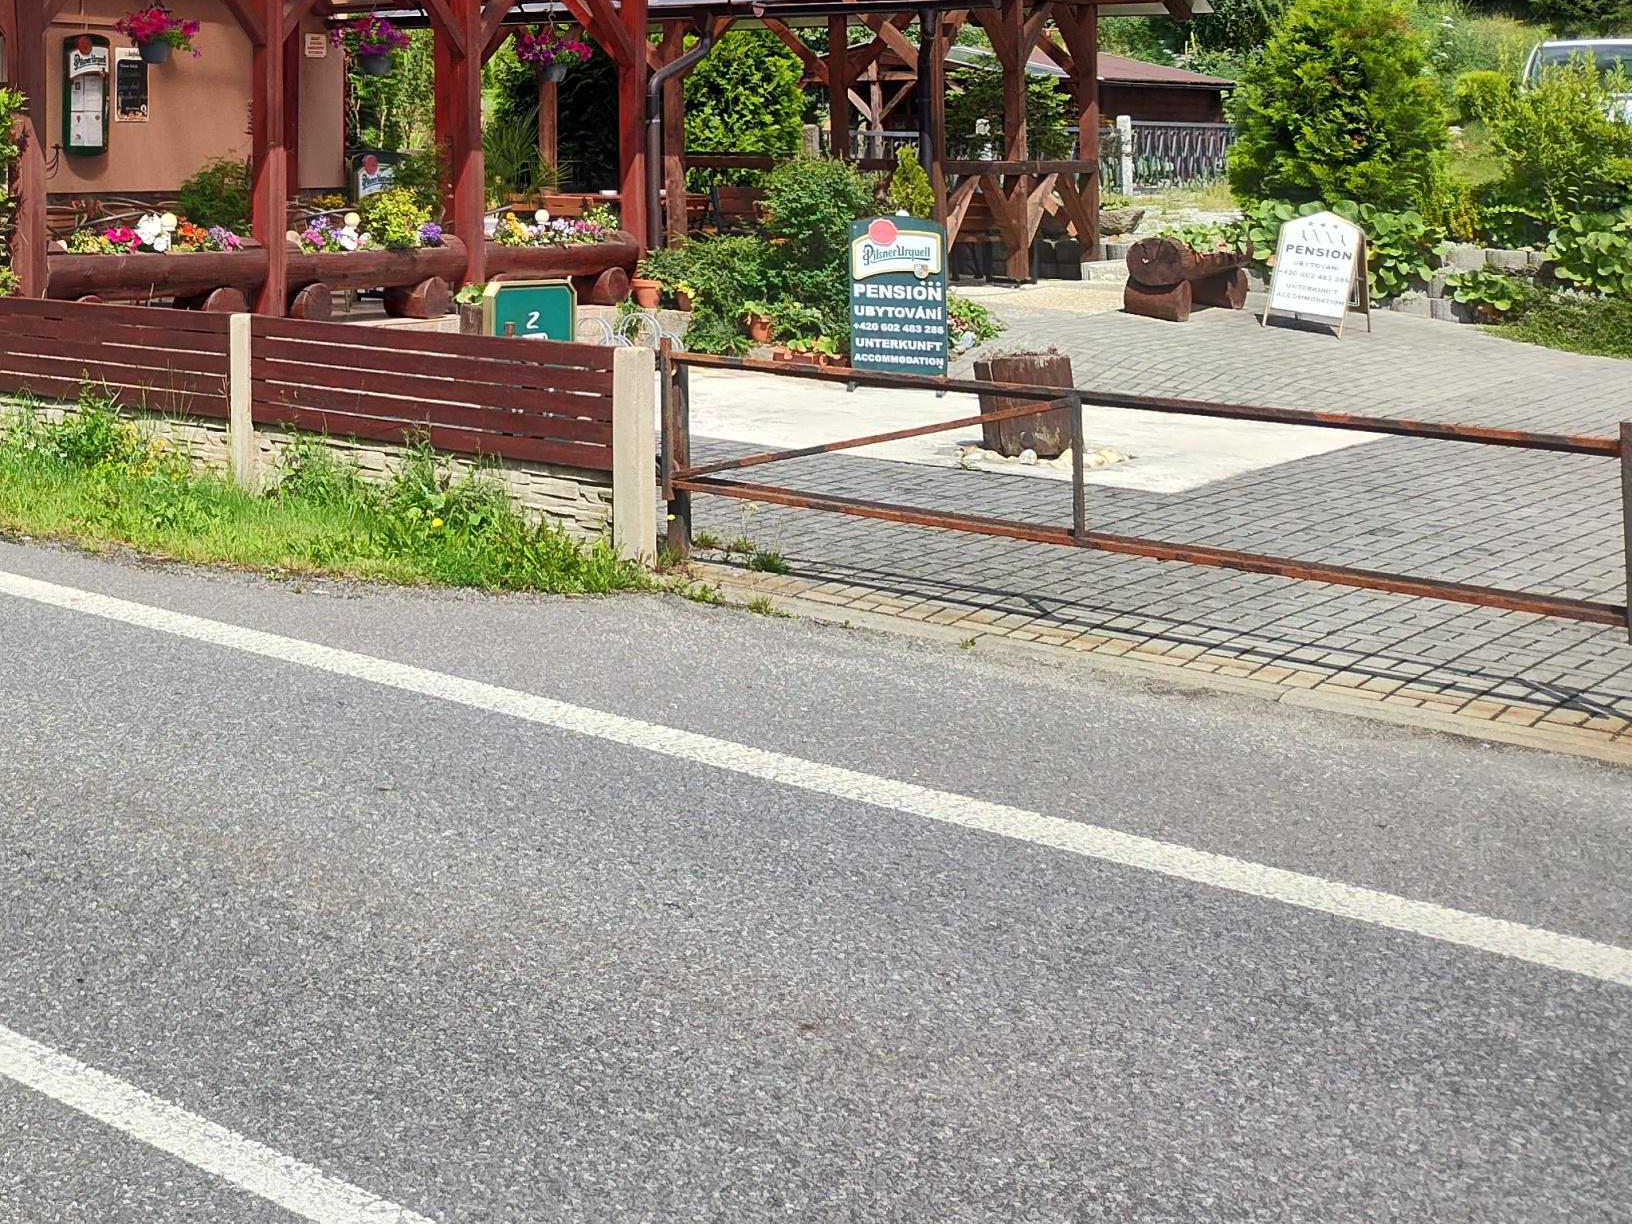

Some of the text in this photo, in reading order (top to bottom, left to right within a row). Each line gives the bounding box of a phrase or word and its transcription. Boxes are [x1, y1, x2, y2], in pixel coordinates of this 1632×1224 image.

[862, 244, 931, 266] Pilsner Urquell
[1285, 243, 1353, 261] PENSION
[853, 283, 942, 301] PENSION
[854, 304, 942, 320] UBYTOVÁNÍ
[853, 321, 879, 331] +420
[880, 322, 900, 332] 602
[855, 337, 943, 352] UNTERKUNFT
[854, 353, 944, 366] ACCOMMODATION
